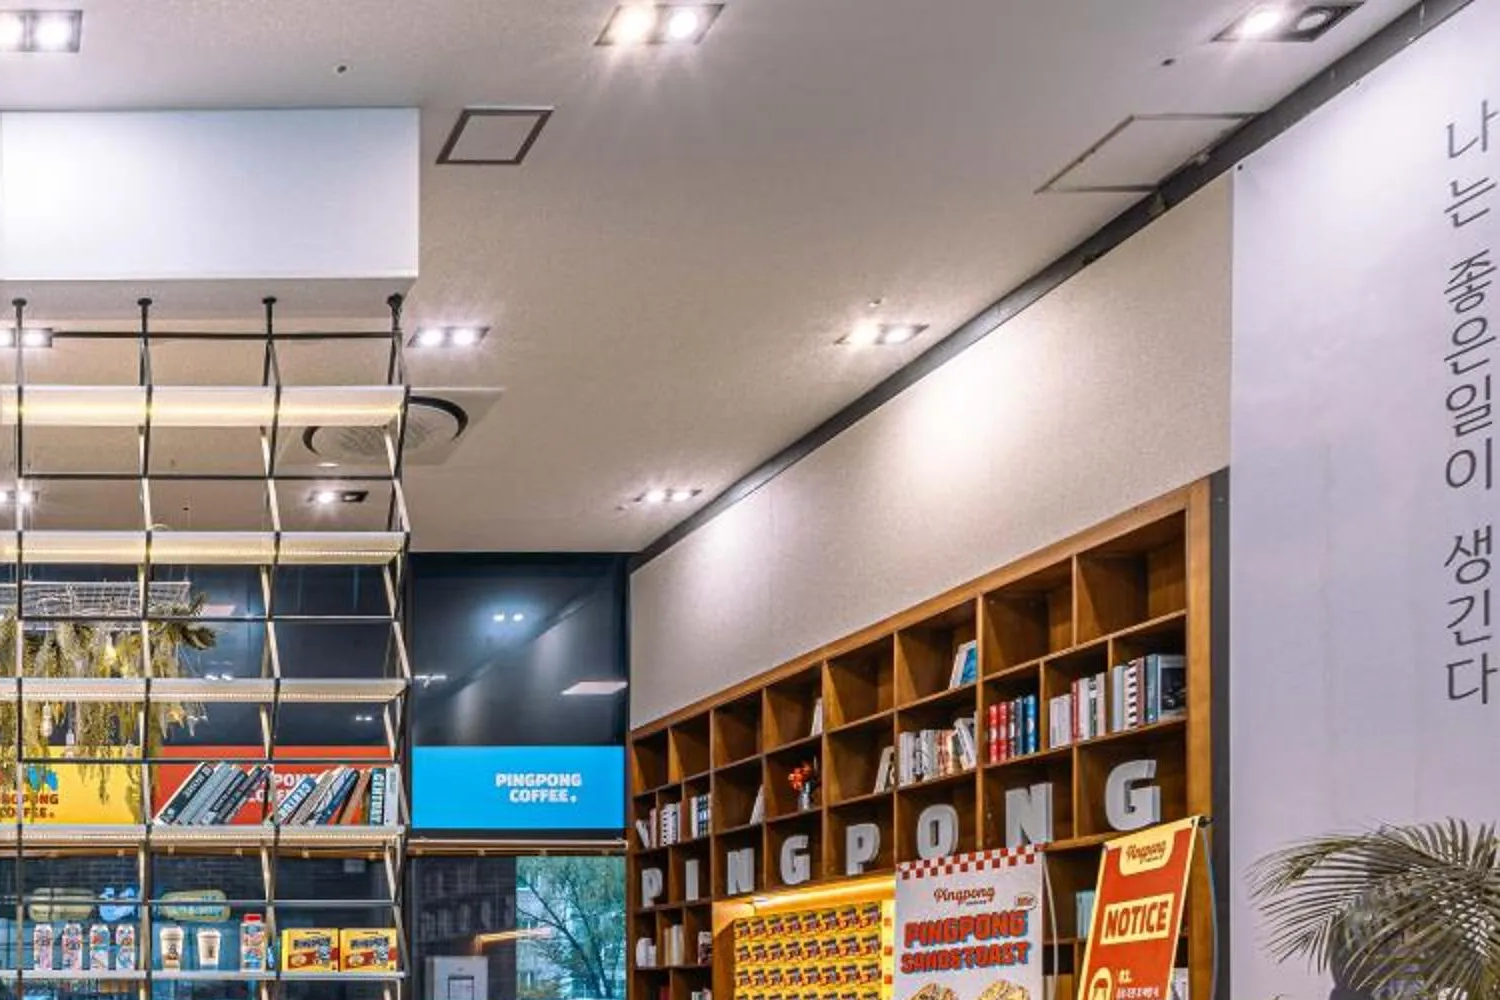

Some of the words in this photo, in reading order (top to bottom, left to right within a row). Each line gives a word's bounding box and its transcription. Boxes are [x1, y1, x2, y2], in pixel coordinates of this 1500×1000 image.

[1444, 524, 1498, 704] 생긴다
[496, 773, 583, 787] PINGPONG
[933, 887, 995, 905] Pingpong
[904, 910, 1029, 949] PINGPONG
[1105, 900, 1169, 939] NOTICE
